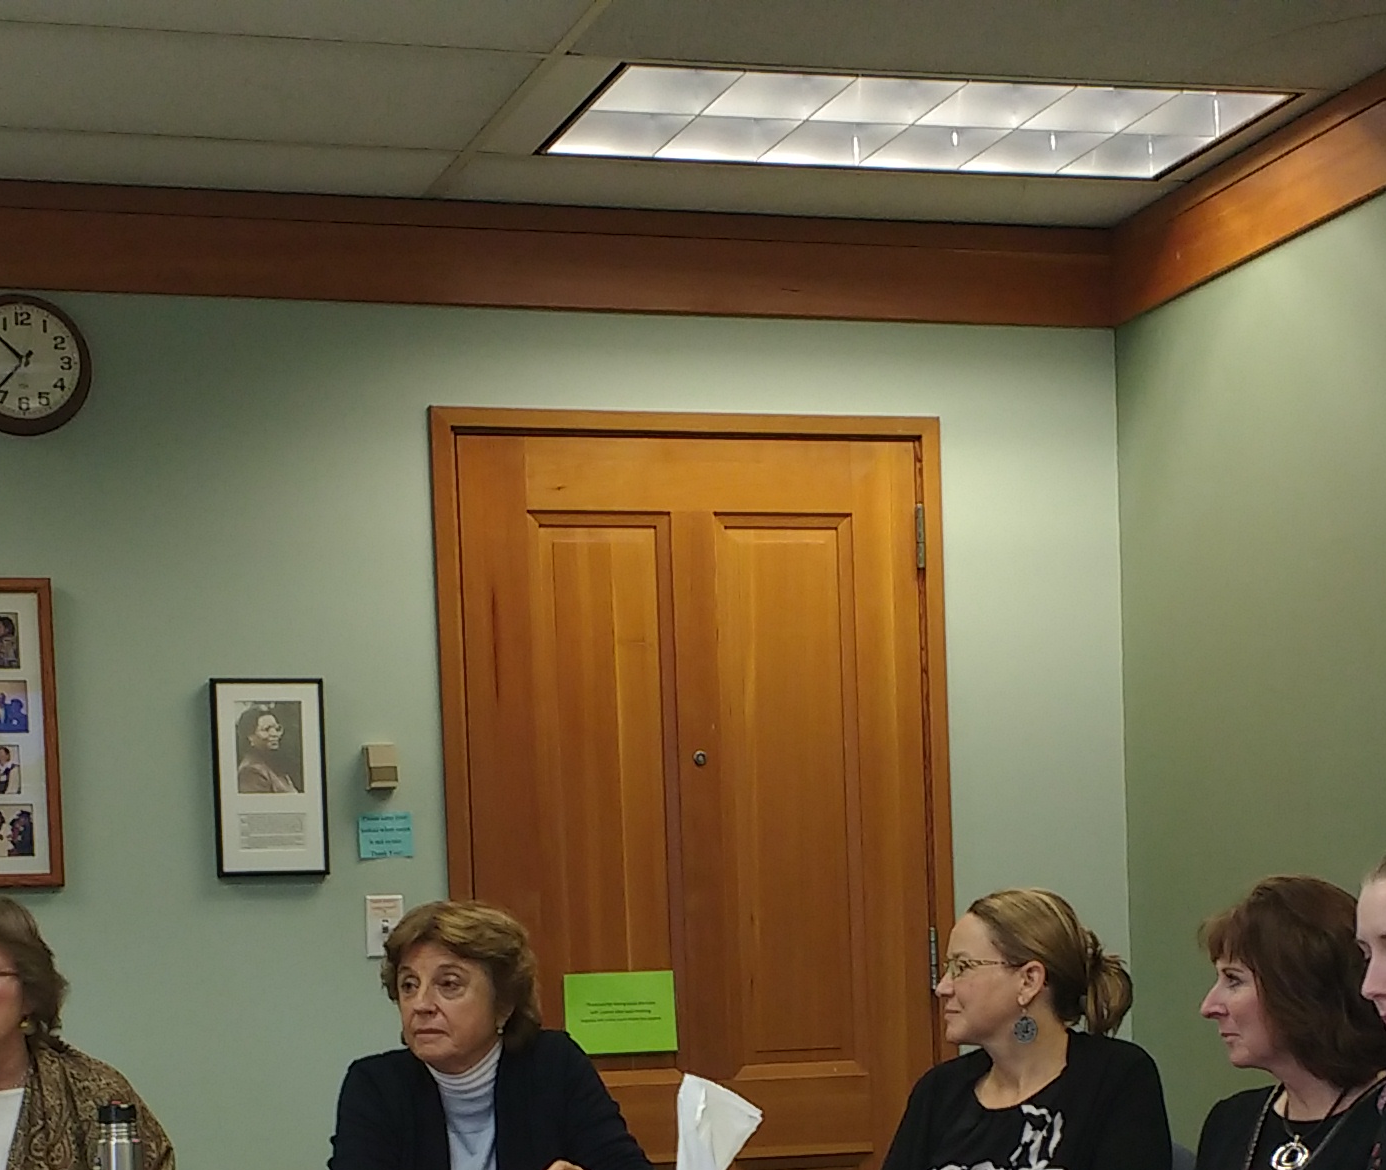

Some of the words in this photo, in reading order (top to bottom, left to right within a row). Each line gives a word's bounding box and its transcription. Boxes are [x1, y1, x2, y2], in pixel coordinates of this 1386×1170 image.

[14, 311, 31, 326] 12
[42, 319, 47, 333] 1
[53, 335, 66, 350] 2
[60, 355, 73, 371] 3
[52, 377, 66, 391] 4
[18, 396, 30, 411] 6
[38, 391, 50, 407] 5
